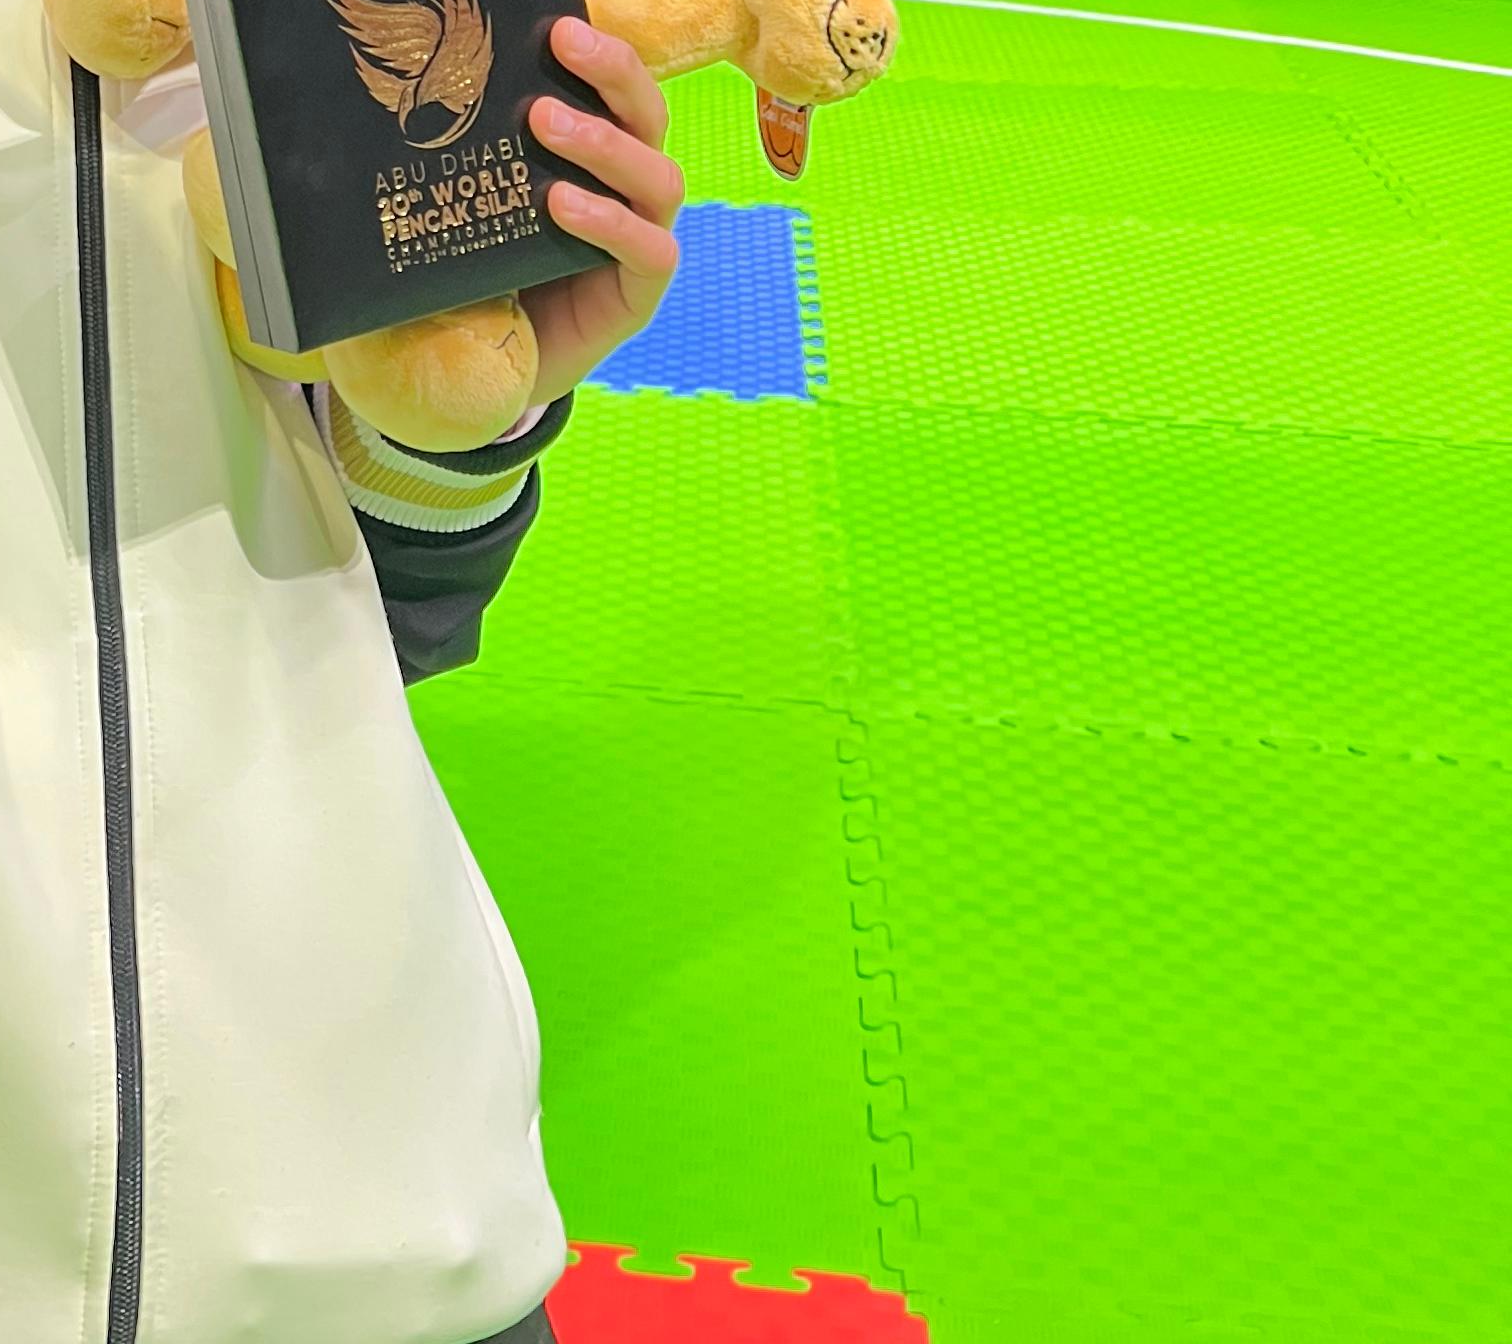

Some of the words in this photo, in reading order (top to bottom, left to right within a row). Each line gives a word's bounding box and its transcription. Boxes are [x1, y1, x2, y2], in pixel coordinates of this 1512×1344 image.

[375, 160, 426, 194] ABU
[440, 134, 525, 176] DHABI
[377, 188, 424, 222] 20th
[429, 161, 529, 207] WORLD
[382, 200, 473, 246] PENCAK
[474, 183, 532, 219] SILAT
[387, 208, 537, 260] CHAMPIONSHIP
